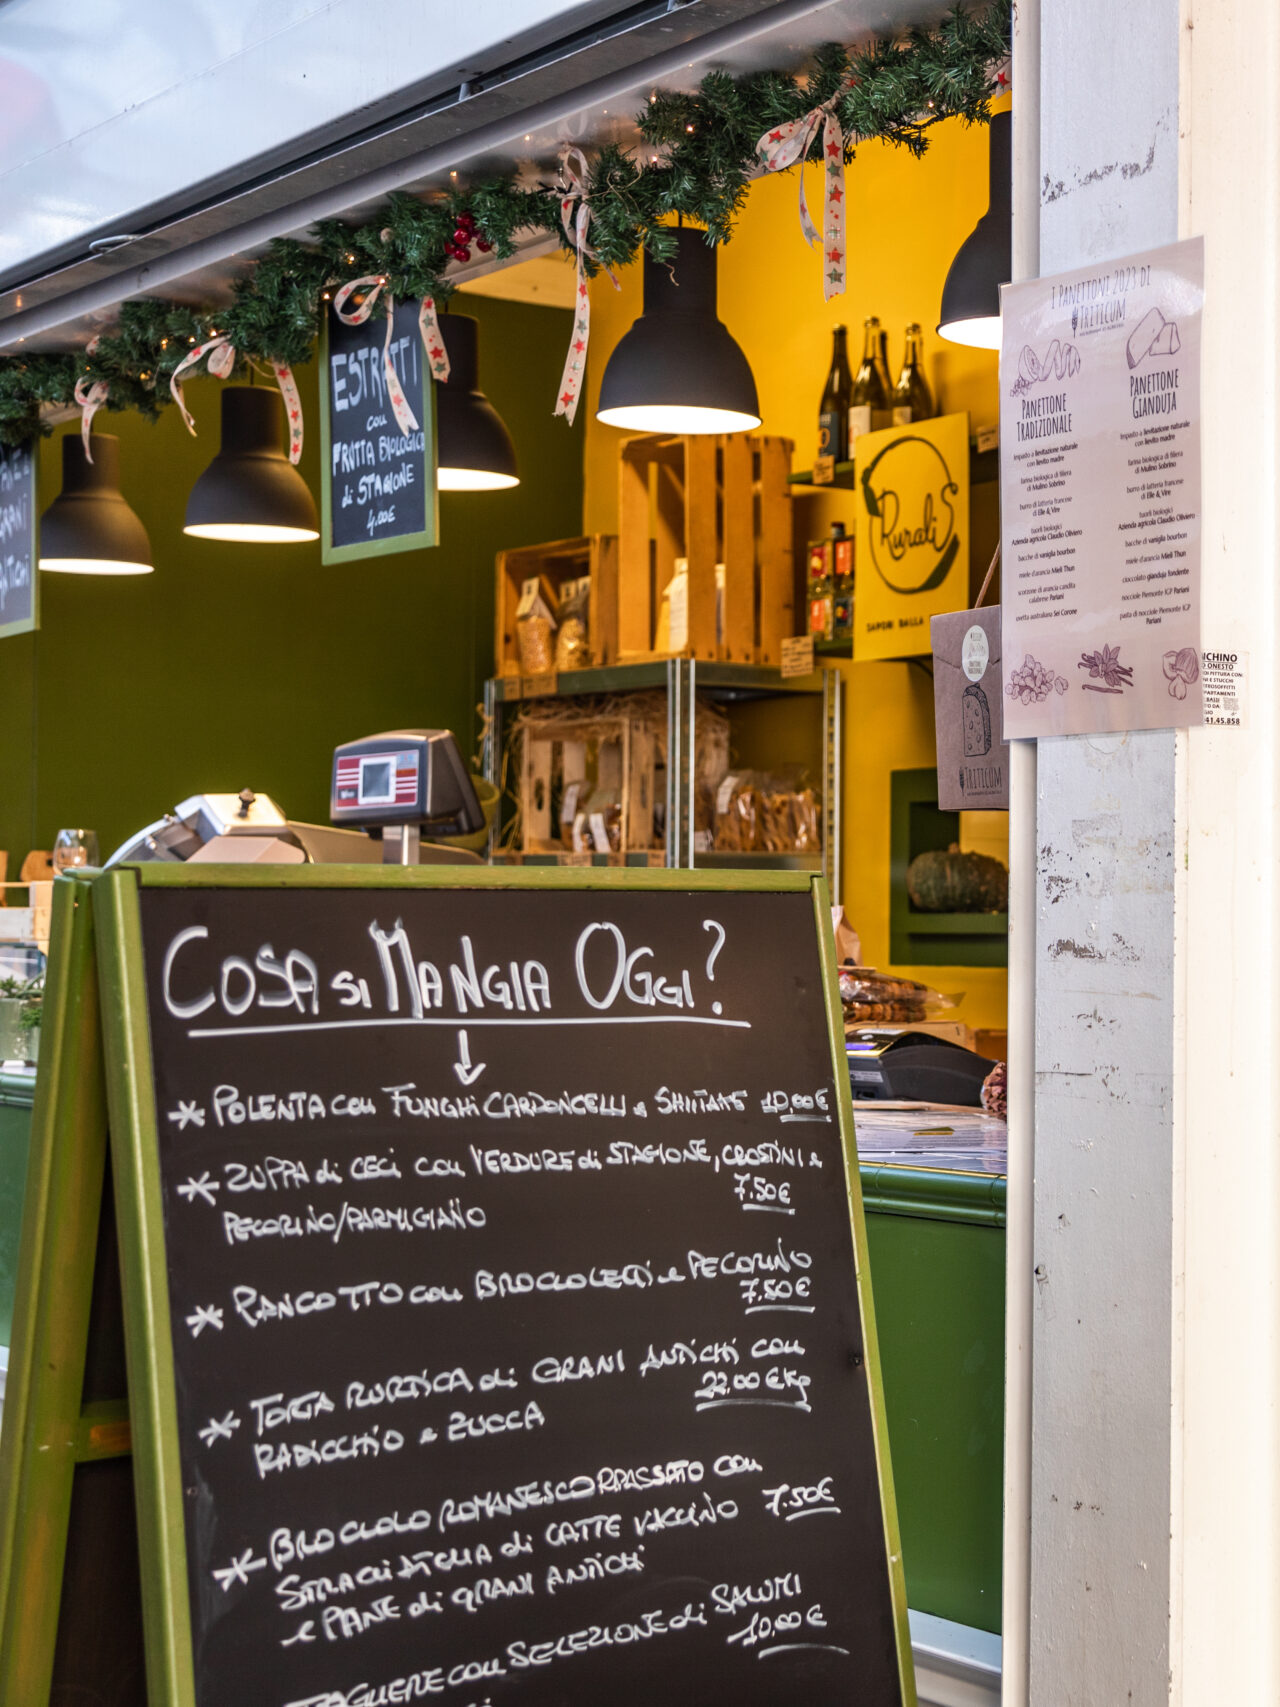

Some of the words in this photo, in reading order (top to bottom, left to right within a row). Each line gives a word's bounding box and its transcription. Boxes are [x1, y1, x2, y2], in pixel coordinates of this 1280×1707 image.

[1113, 266, 1136, 295] 2023
[1079, 298, 1126, 329] TRITICUM
[1130, 368, 1179, 397] PANETTONE
[1022, 393, 1067, 420] PANETTONE
[1132, 391, 1176, 419] GIANDUJA
[1017, 413, 1072, 442] TRADIZIONALE
[1160, 432, 1175, 442] madre
[332, 440, 375, 477] FRUTTA
[341, 484, 353, 509] di
[1207, 662, 1234, 670] ONESTO
[965, 766, 1001, 790] TRITICUM
[163, 925, 319, 1019] COSA
[368, 916, 552, 1020] MANGIA
[575, 919, 726, 1015] OGGI?
[212, 1084, 327, 1127] POLENTA
[380, 1082, 480, 1119] FUNGHI
[223, 1155, 310, 1192] ZUPPA
[314, 1158, 343, 1185] di
[350, 1147, 401, 1180] CECI
[470, 1144, 576, 1175] VERDURE
[577, 1149, 602, 1171] di
[722, 1140, 804, 1168] CROSTINI
[232, 1281, 404, 1328] PANCOTTO
[687, 1237, 813, 1280] PECORINO
[250, 1391, 336, 1437] TORTA
[479, 1367, 518, 1392] di
[531, 1349, 625, 1384] GRANI
[449, 1400, 546, 1441] ZUCCA
[500, 1530, 534, 1556] di
[322, 1595, 402, 1641] PANE
[408, 1590, 444, 1618] di
[506, 1608, 668, 1668] SELEZIONE
[668, 1603, 708, 1630] di
[711, 1572, 802, 1615] SALUMI
